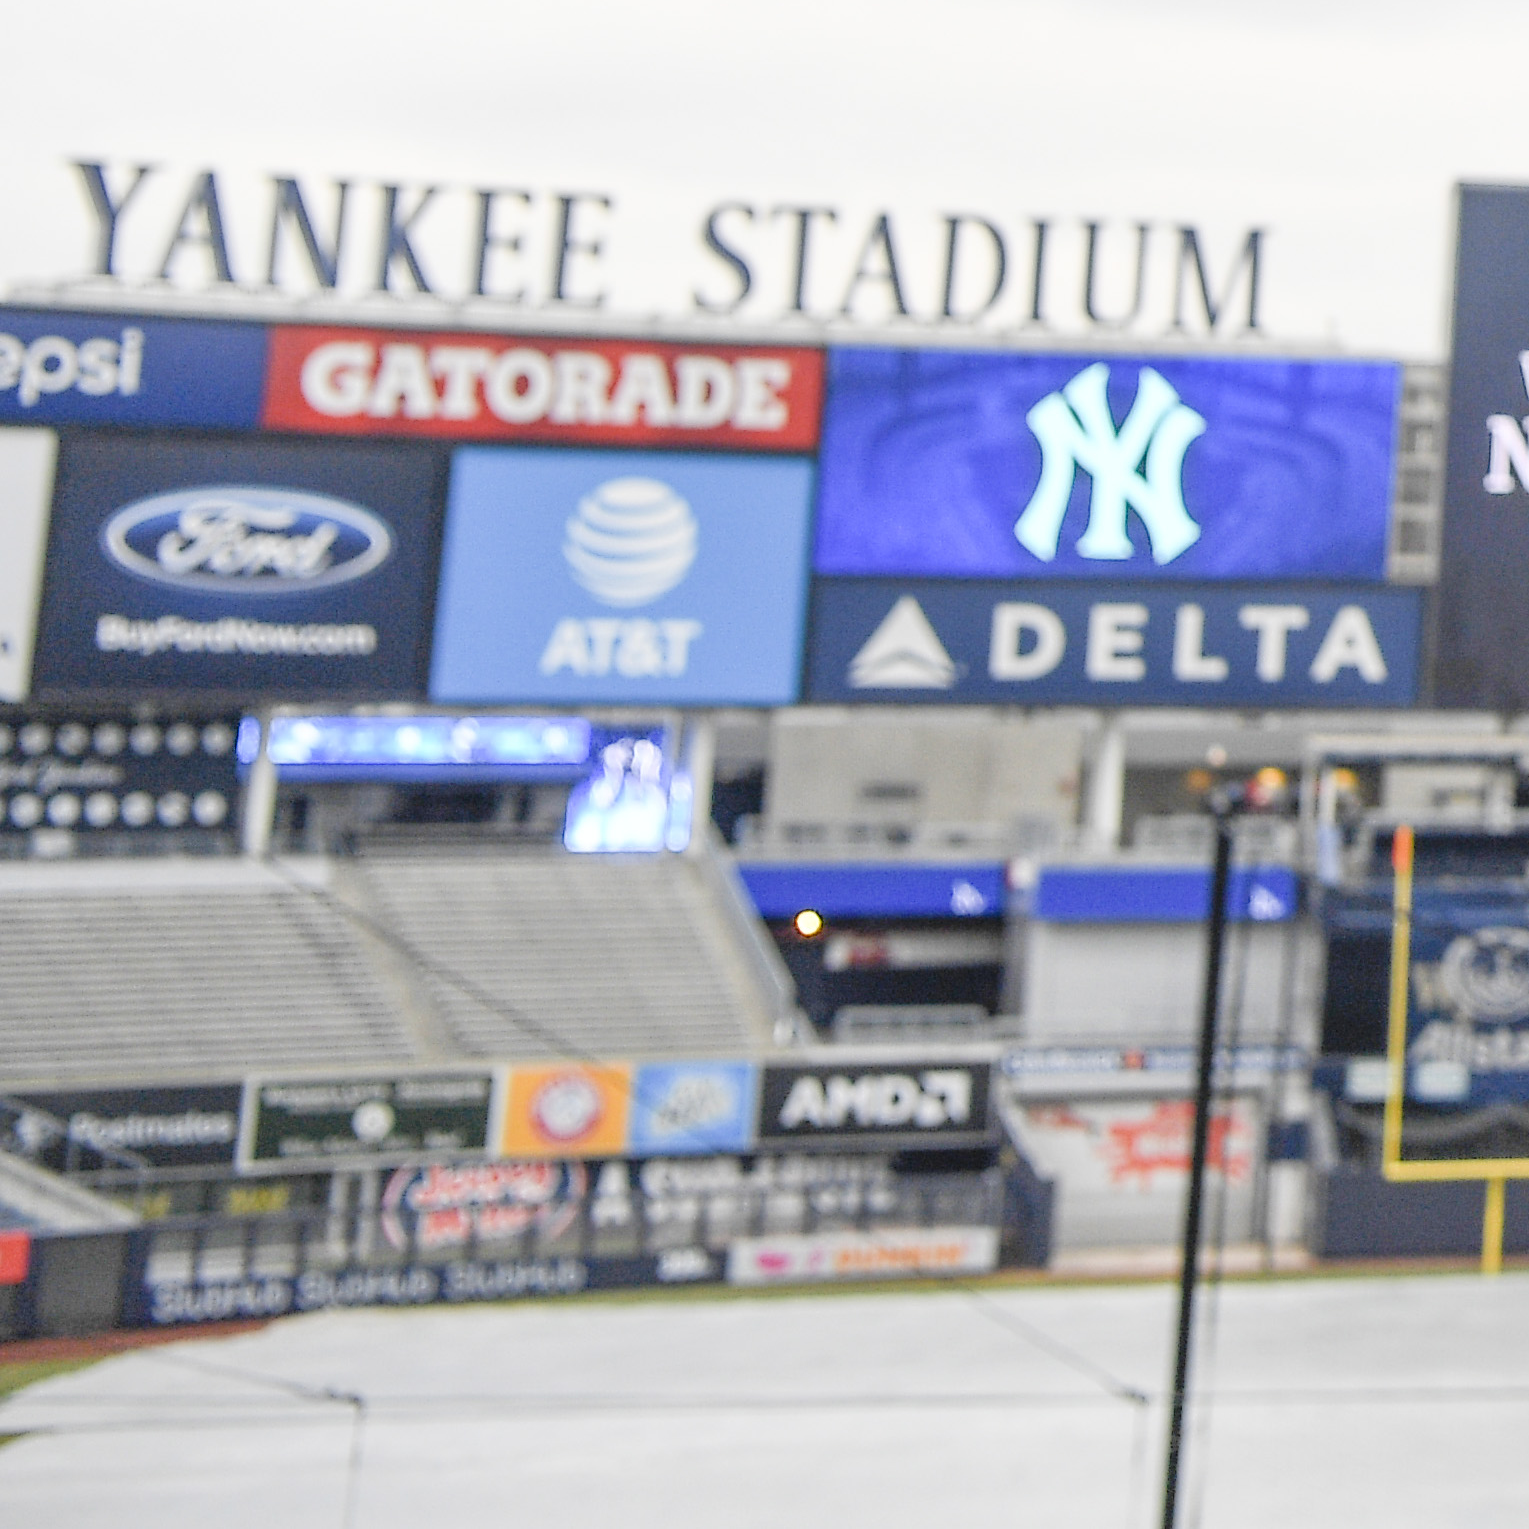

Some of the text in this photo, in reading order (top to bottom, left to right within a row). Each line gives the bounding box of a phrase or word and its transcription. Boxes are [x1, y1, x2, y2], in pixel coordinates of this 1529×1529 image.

[68, 158, 1271, 339] YANKEE STADIUM
[300, 341, 792, 431] GATORADE
[1012, 361, 1207, 566] NY
[156, 498, 340, 578] Ford
[538, 616, 701, 676] AT&T
[988, 601, 1388, 683] DELTA
[779, 1075, 922, 1129] AMD
